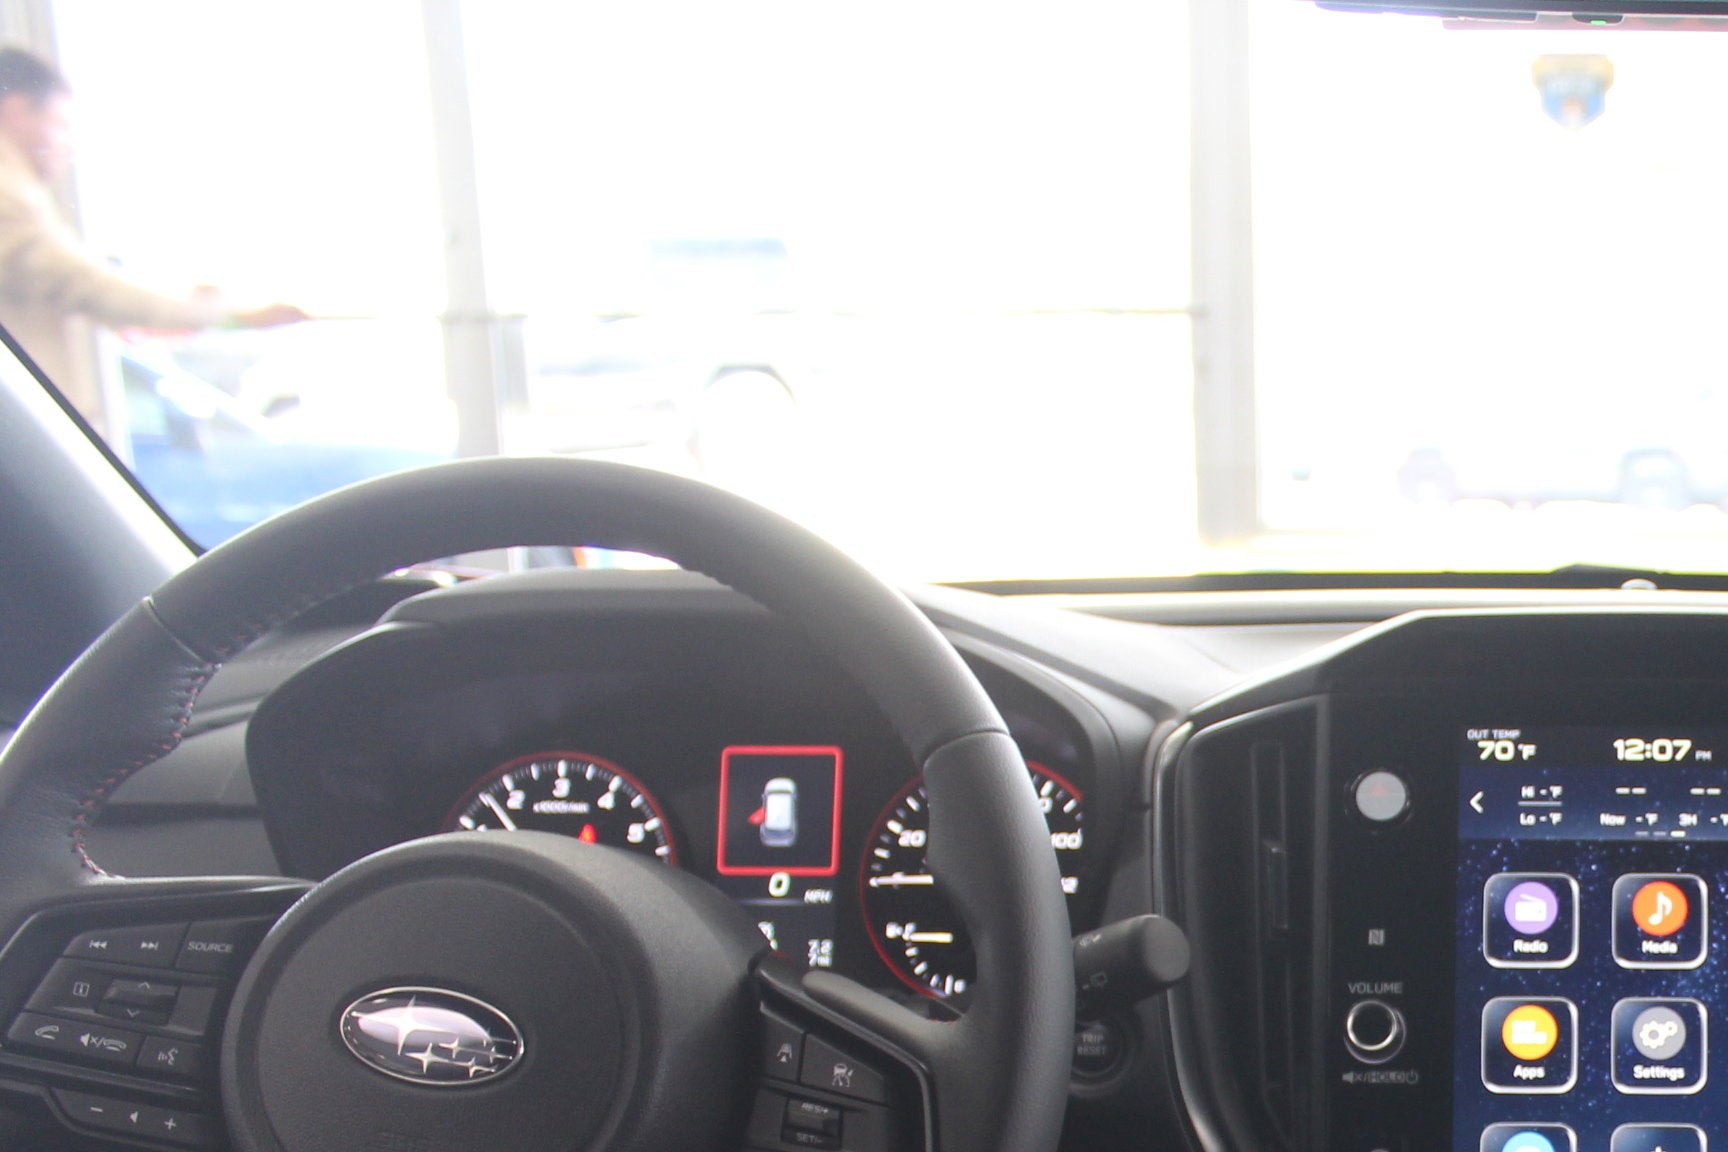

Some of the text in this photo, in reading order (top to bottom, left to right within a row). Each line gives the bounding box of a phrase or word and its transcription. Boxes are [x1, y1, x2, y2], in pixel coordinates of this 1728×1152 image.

[1467, 728, 1521, 740] OUT TEMP
[1613, 738, 1712, 761] 12:07 PM
[553, 777, 570, 798] 3
[1521, 785, 1535, 798] Hi
[506, 790, 526, 810] 2
[597, 792, 616, 810] 4
[1520, 813, 1536, 825] Lo
[1600, 813, 1626, 826] Now
[1678, 813, 1697, 827] 3H
[627, 823, 645, 843] 5
[899, 830, 926, 847] 20
[768, 872, 791, 897] 0
[804, 889, 833, 904] MPH
[187, 941, 233, 953] SOURCE
[1513, 940, 1548, 953] Radio
[1642, 940, 1678, 954] Media
[1348, 983, 1402, 994] VOLUME
[1082, 1033, 1104, 1044] TRIP
[1077, 1046, 1106, 1056] RESET
[1513, 1065, 1545, 1080] Apps
[1633, 1066, 1685, 1081] Settings
